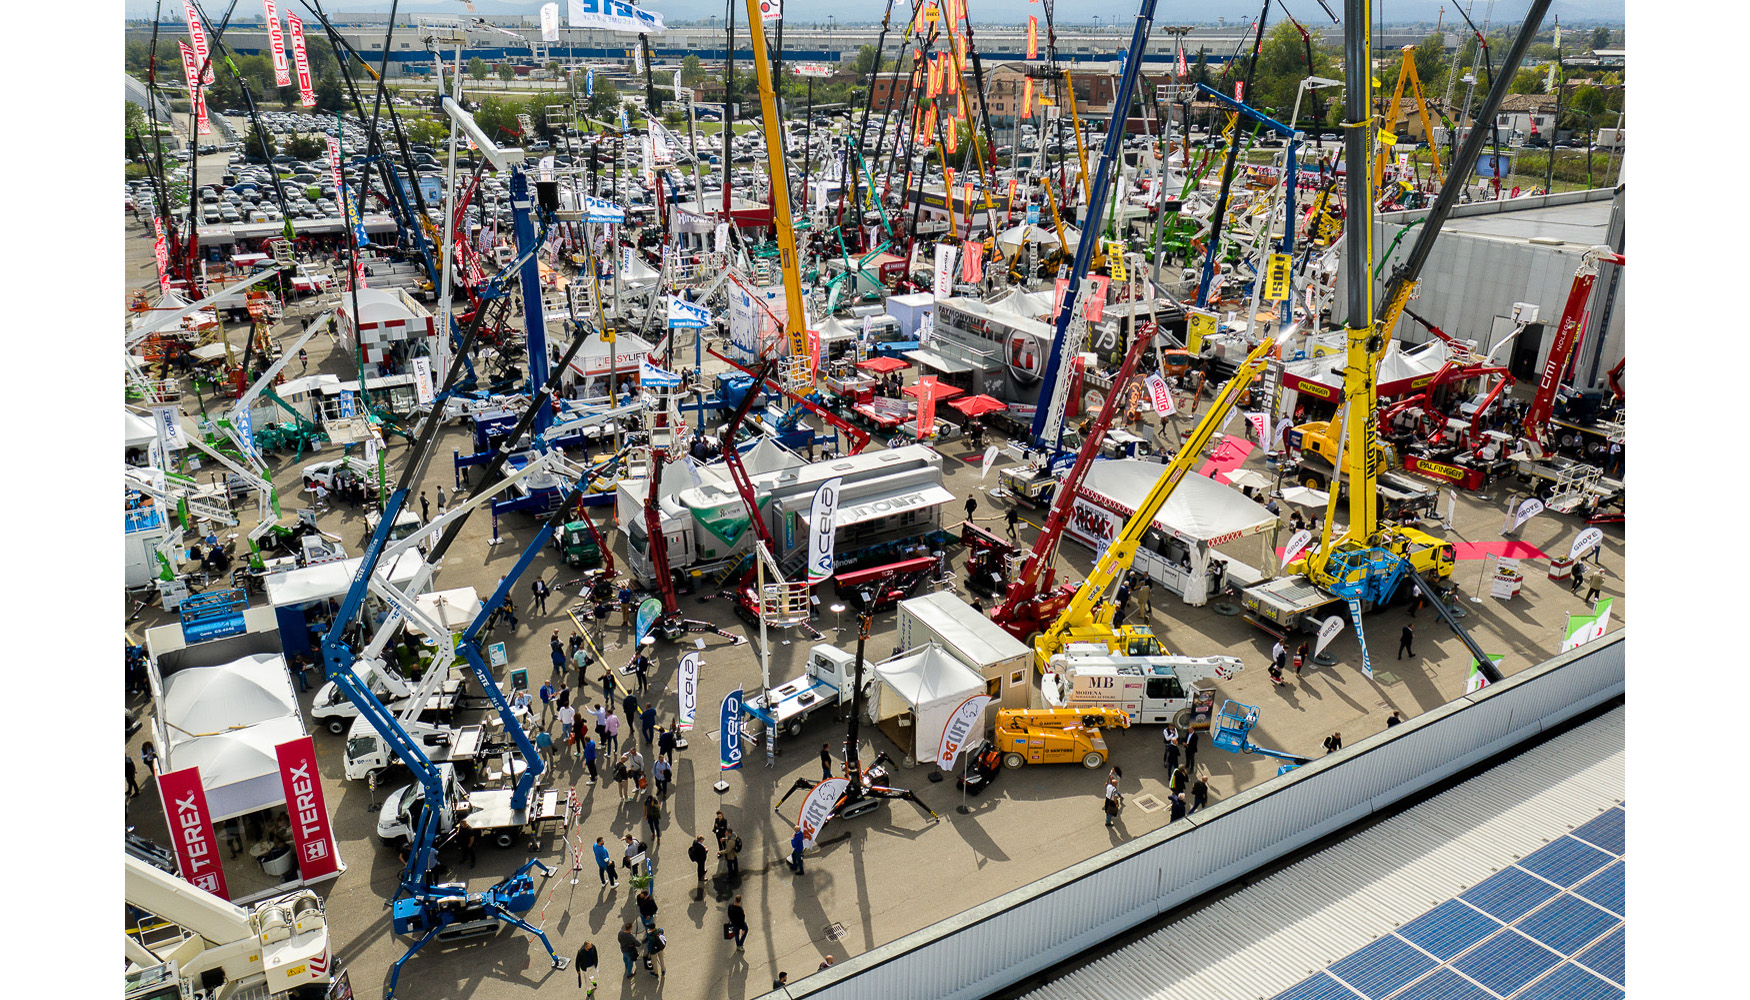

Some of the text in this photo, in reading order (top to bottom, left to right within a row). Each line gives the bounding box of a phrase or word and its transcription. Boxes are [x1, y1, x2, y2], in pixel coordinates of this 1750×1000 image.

[291, 23, 311, 90] FASSI
[1271, 256, 1285, 298] ISOLI
[1540, 360, 1557, 390] CMI
[1152, 377, 1170, 412] ORMIG
[1300, 382, 1328, 396] PALFINGER
[1366, 418, 1376, 480] BALDINI
[1420, 460, 1462, 478] PALFINGER
[1517, 501, 1540, 518] GROVE
[1286, 533, 1307, 555] GROVE
[1573, 530, 1599, 551] GROVE
[1322, 619, 1339, 638] GROVE
[1088, 676, 1115, 689] MB
[290, 762, 321, 840] TEREX
[175, 797, 210, 874] TEREX
